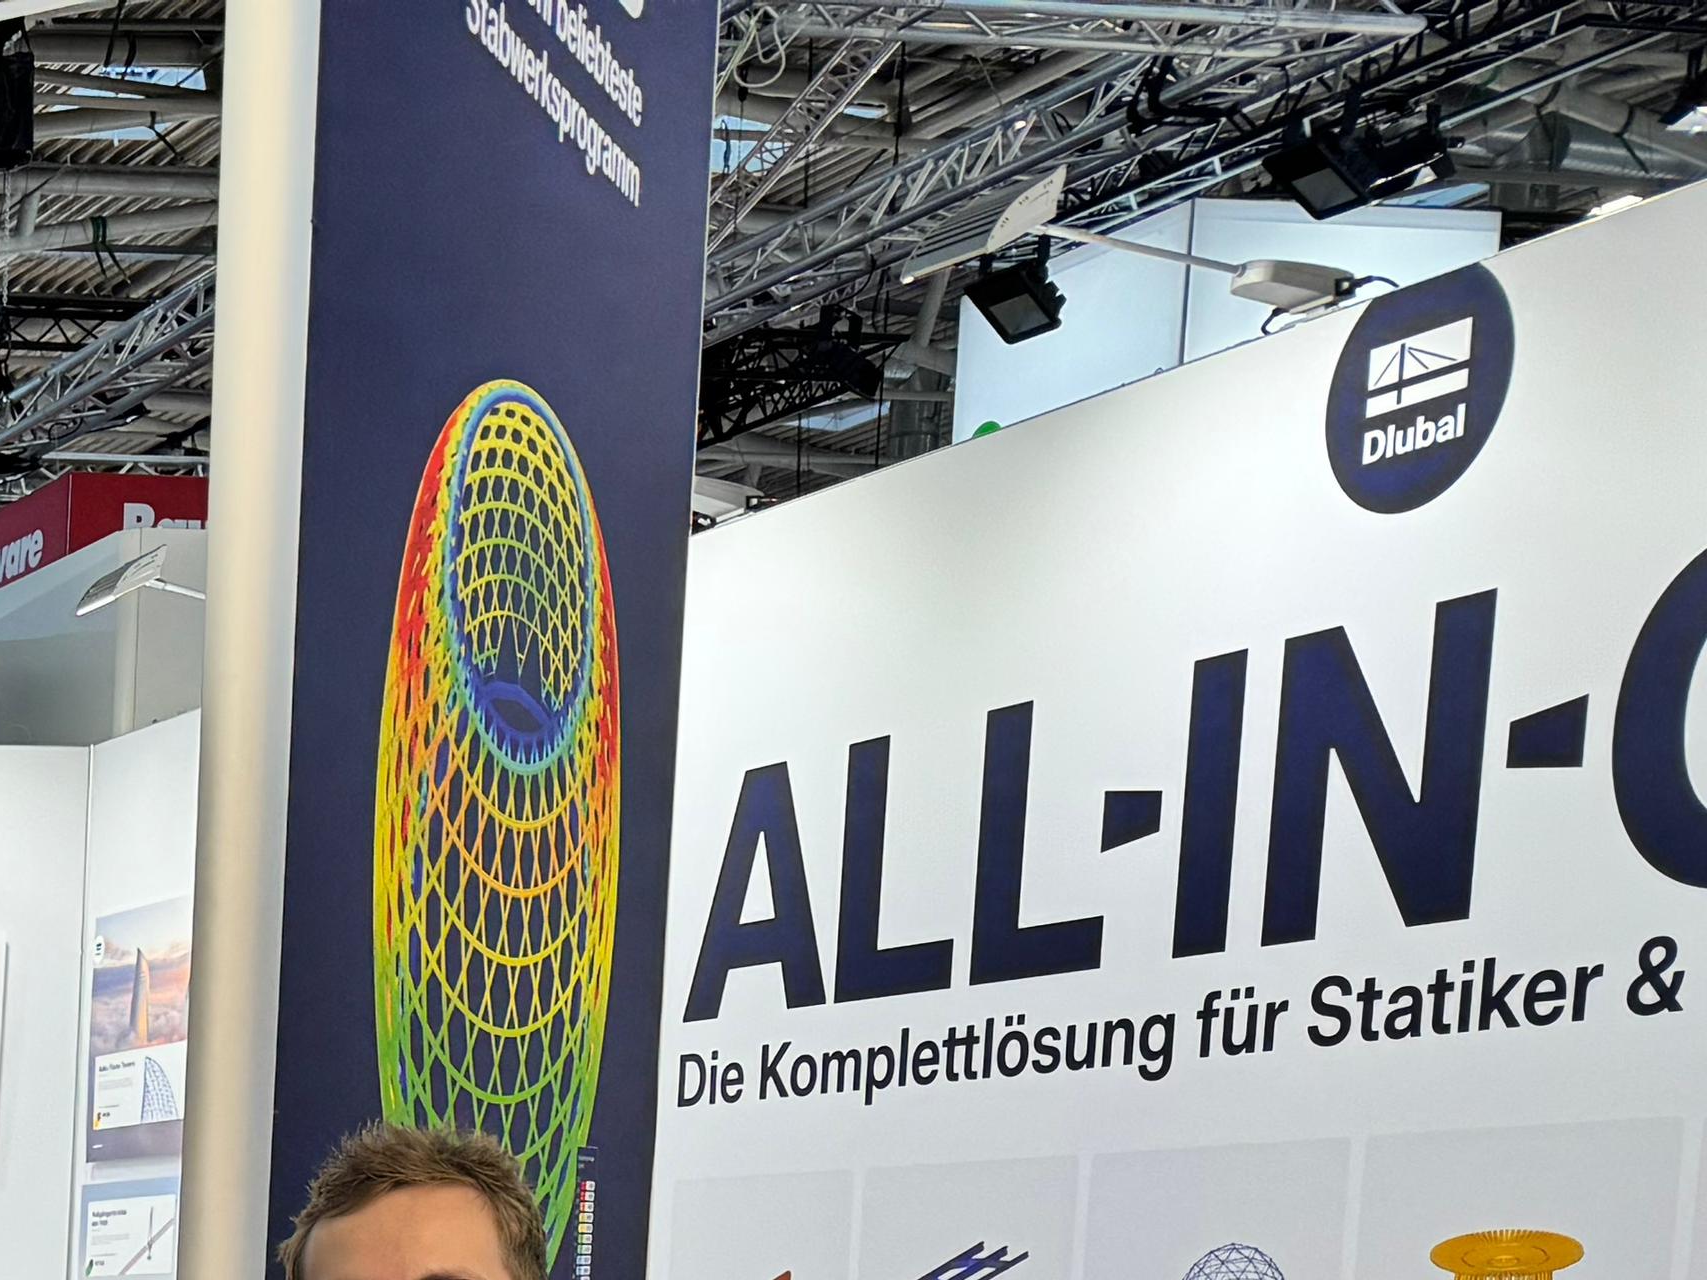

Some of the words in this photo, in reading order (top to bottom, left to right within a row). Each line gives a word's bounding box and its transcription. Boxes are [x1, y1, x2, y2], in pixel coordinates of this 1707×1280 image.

[1361, 405, 1466, 466] Dlubal
[677, 1050, 745, 1108] Die
[760, 1012, 1176, 1106] Komplettlösung
[1196, 987, 1289, 1058] für
[1307, 957, 1605, 1047] Statiker
[1626, 935, 1685, 1016] &
